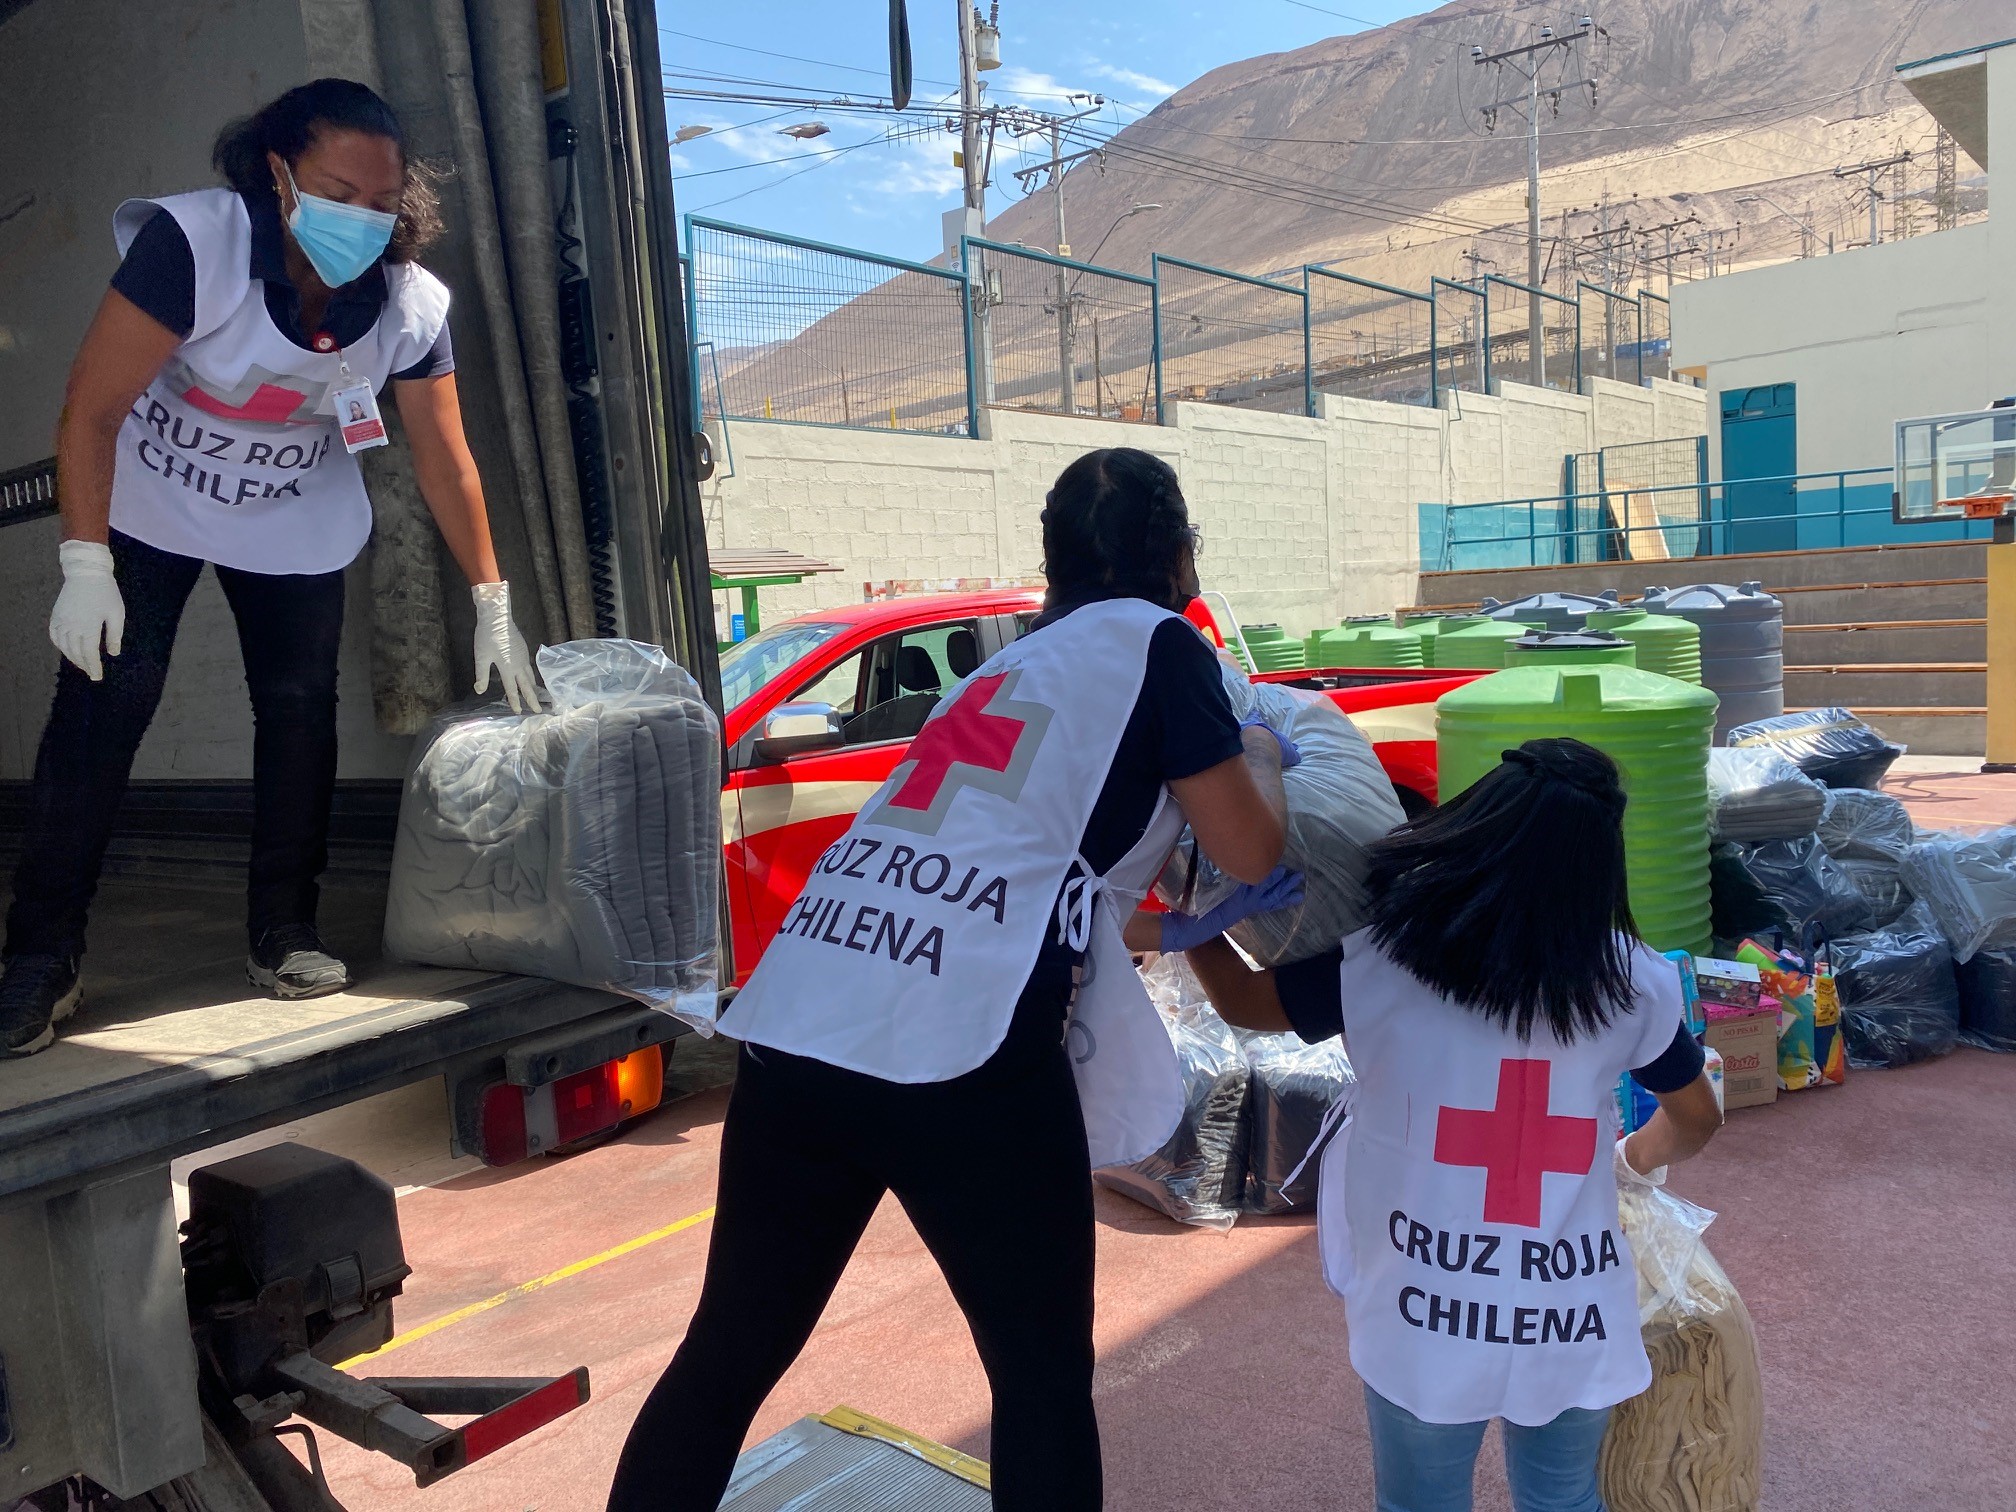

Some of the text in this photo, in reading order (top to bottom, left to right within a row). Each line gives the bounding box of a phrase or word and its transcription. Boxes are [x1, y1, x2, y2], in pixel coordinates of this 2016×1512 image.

[811, 838, 1008, 924] RUZ ROJA
[1724, 1025, 1759, 1037] NO PISAR
[1725, 1055, 1760, 1071] Costa
[1389, 1210, 1620, 1282] CRUZ ROJA
[1398, 1286, 1607, 1345] CHILENA
